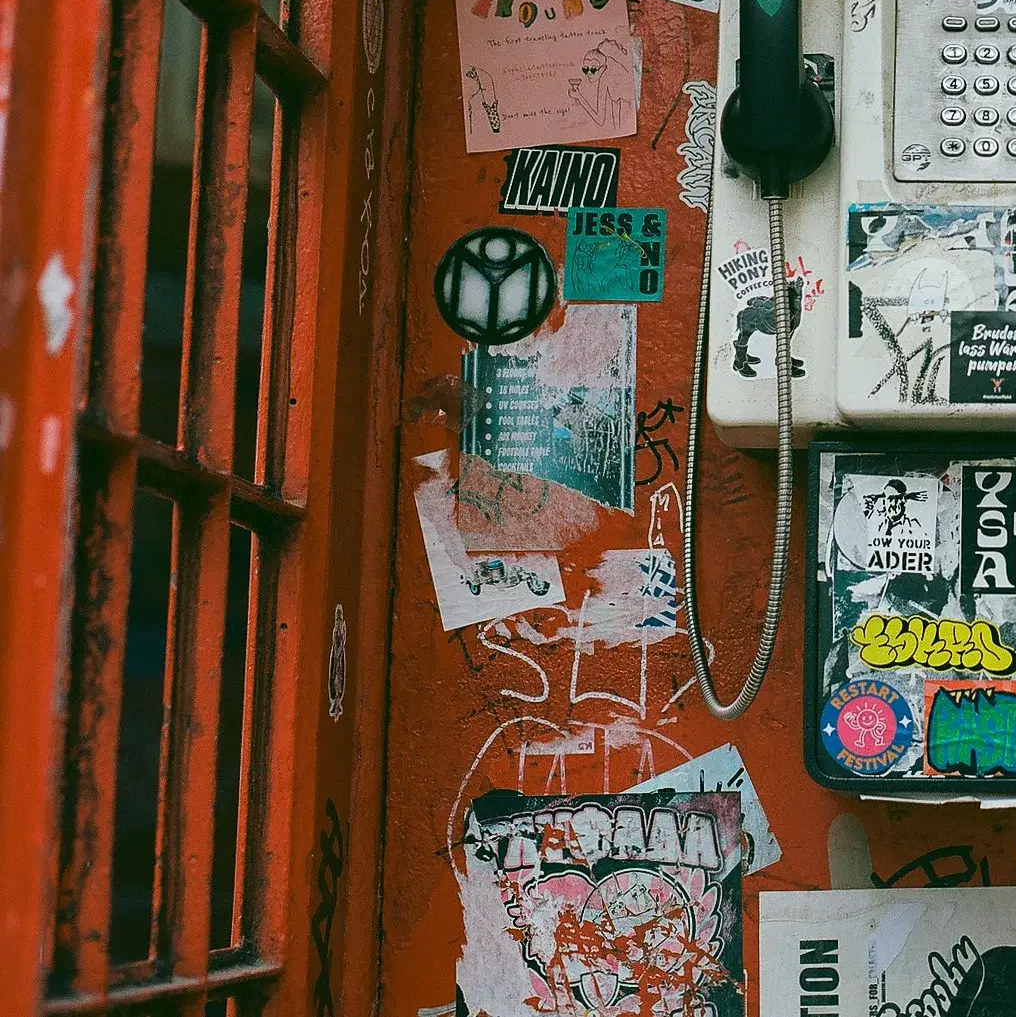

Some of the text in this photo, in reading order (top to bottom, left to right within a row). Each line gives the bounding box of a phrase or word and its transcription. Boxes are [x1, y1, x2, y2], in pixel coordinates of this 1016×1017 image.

[503, 148, 617, 212] KAINO
[571, 212, 662, 238] JESS &
[717, 249, 769, 280] HIKING
[727, 265, 769, 291] PONY
[958, 340, 987, 357] lass
[898, 536, 931, 550] YOUR
[829, 681, 900, 712] RESTART
[835, 741, 905, 773] FESTIVAL
